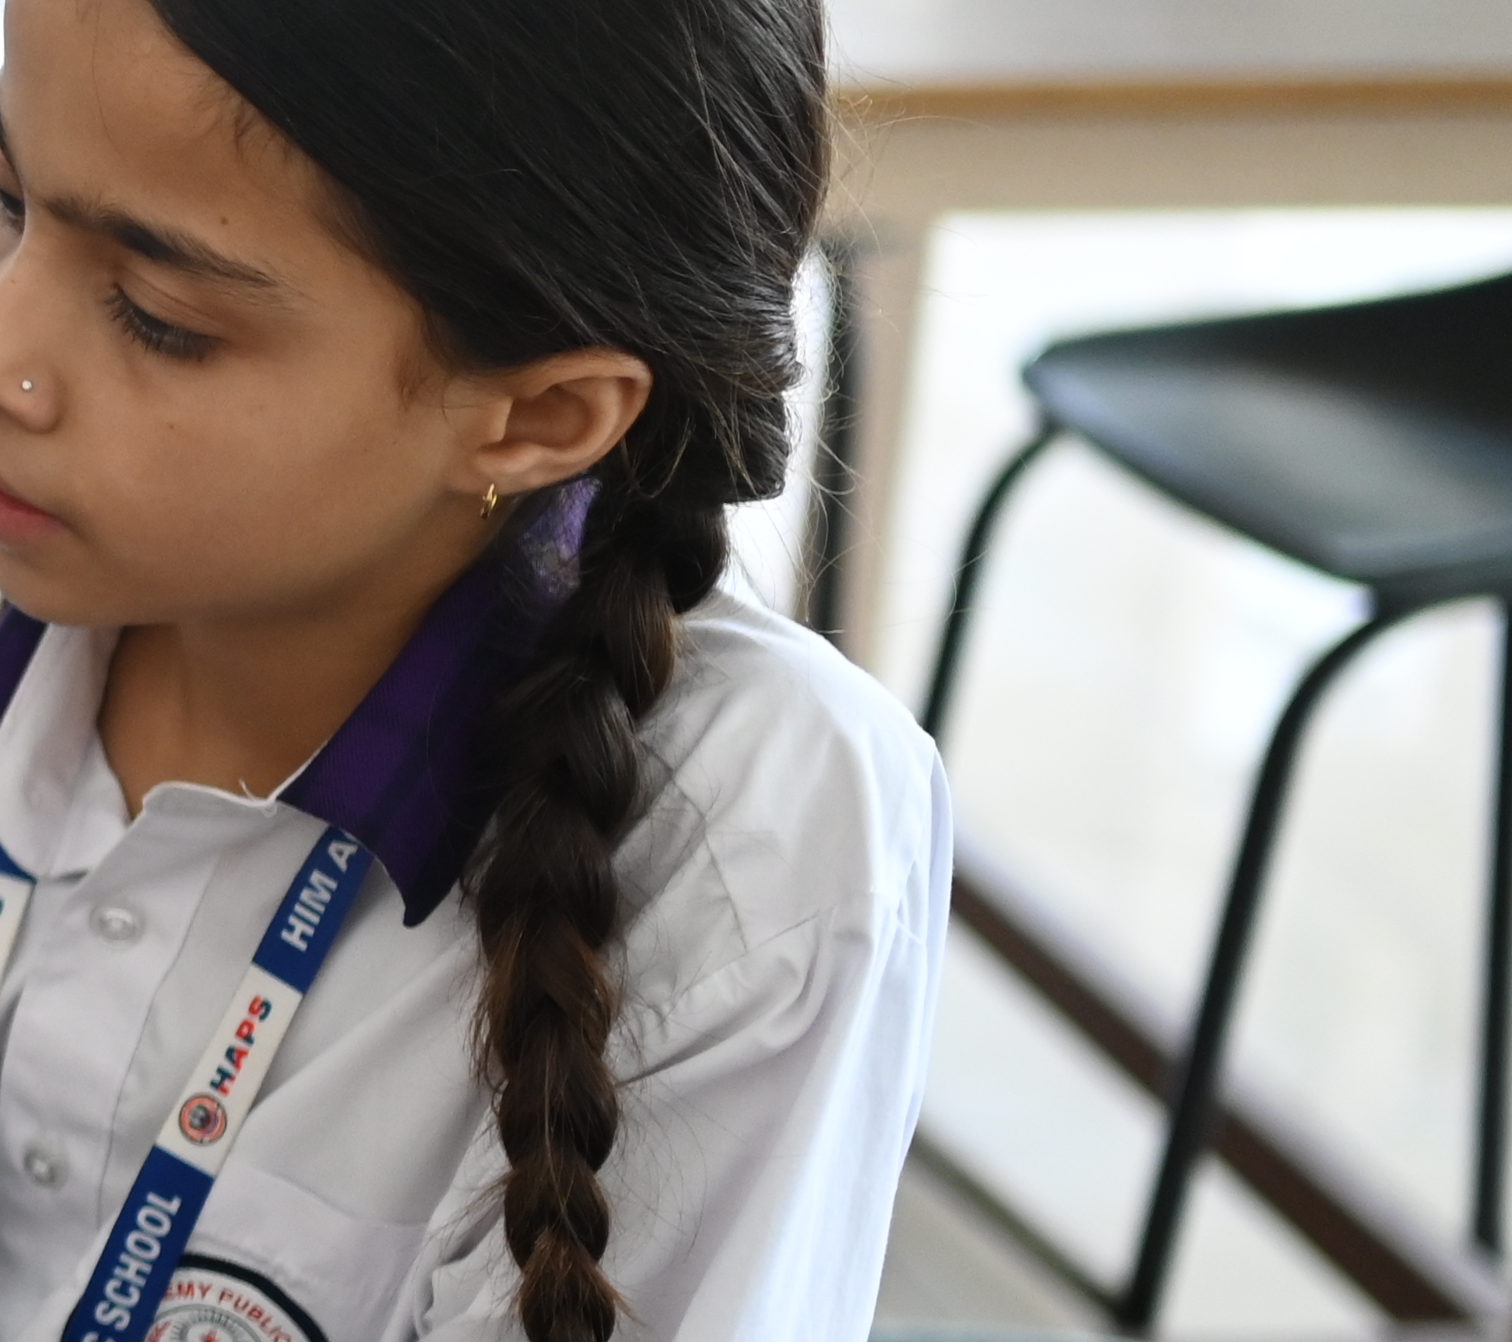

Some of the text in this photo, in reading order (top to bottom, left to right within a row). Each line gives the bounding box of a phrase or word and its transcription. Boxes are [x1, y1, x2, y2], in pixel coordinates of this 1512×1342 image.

[281, 868, 339, 953] HIM
[210, 994, 273, 1097] HAPS
[95, 1189, 182, 1335] SCHOOL
